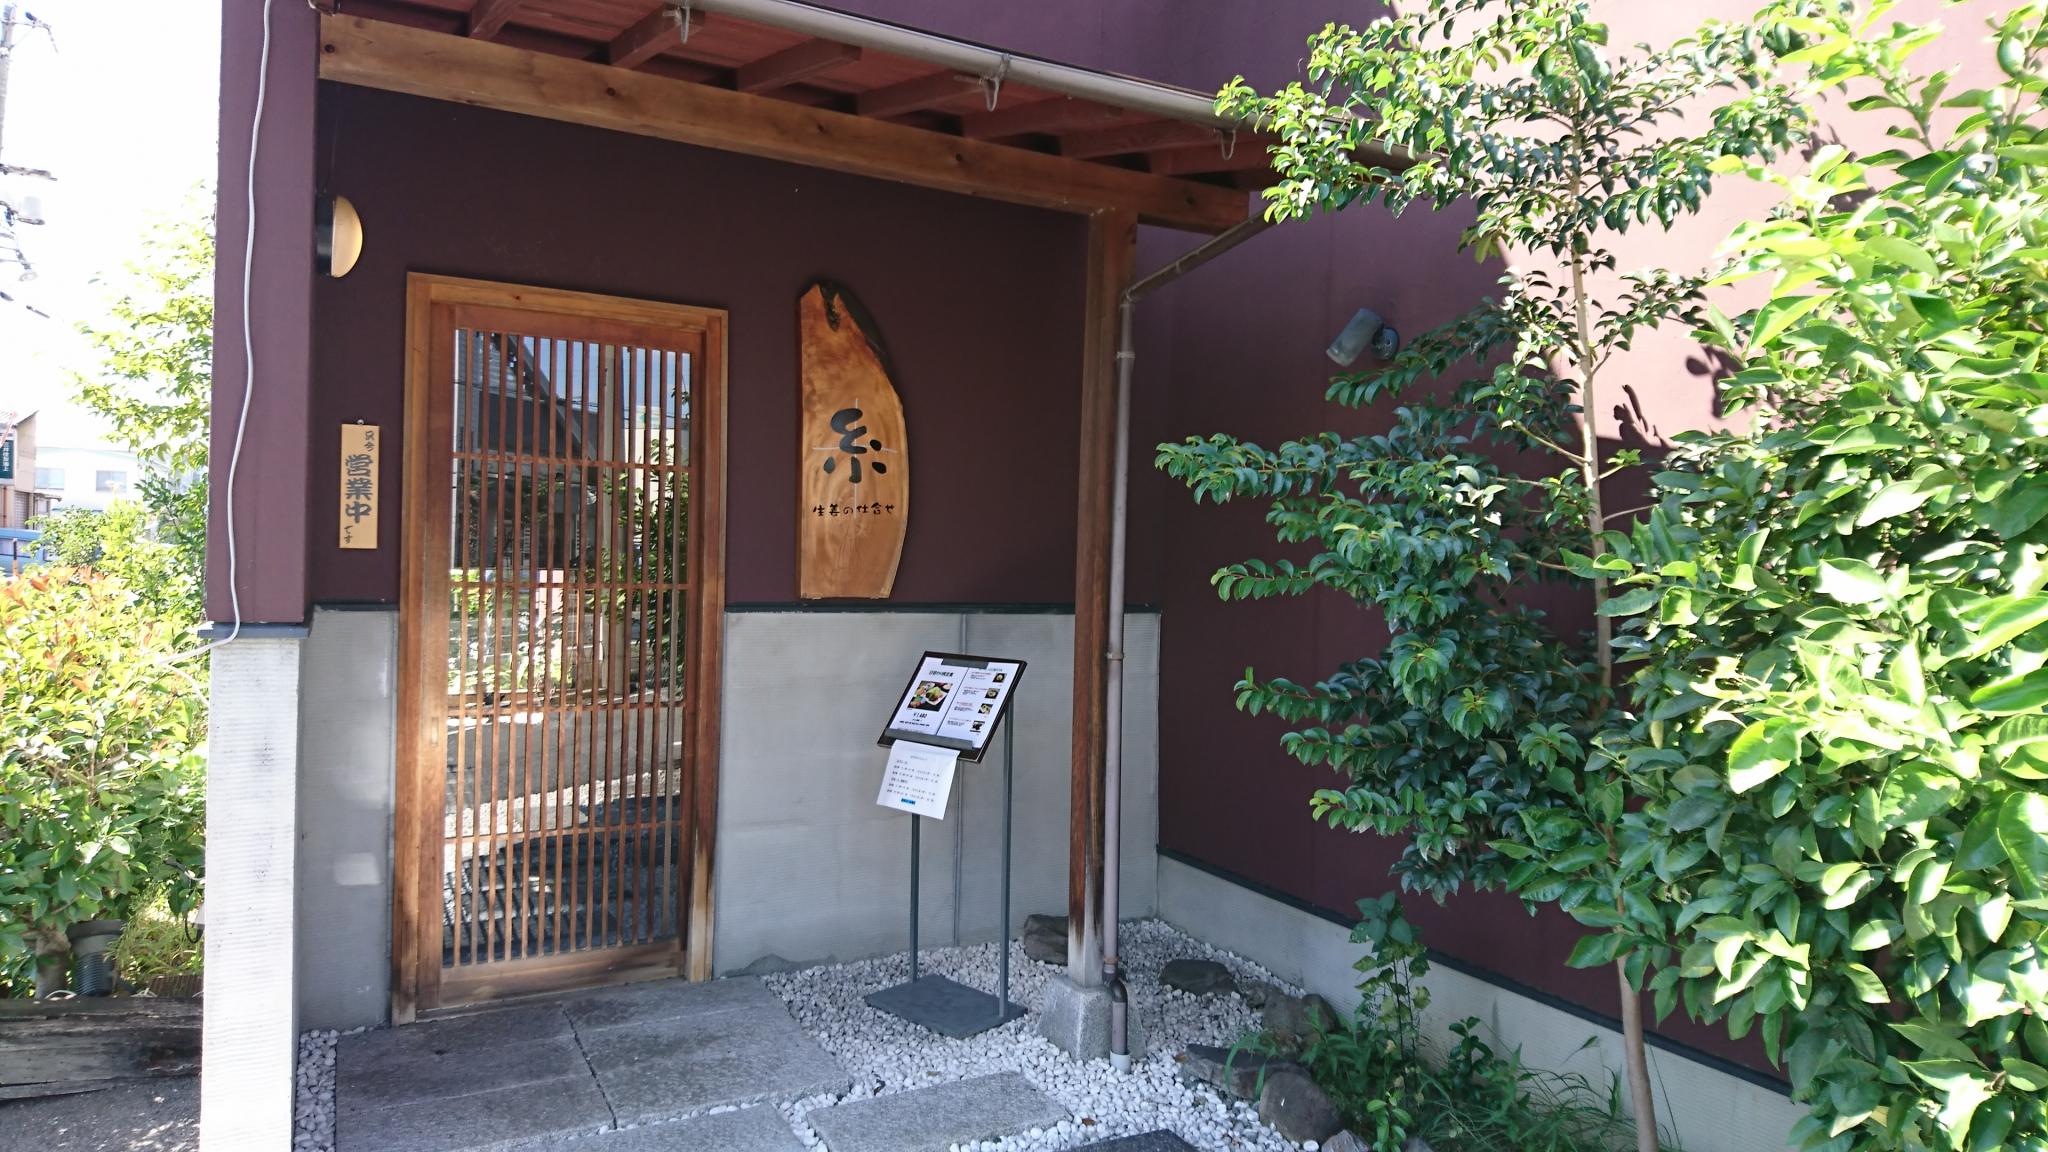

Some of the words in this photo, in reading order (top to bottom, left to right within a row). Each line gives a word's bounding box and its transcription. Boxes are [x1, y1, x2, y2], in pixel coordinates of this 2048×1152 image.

[823, 408, 887, 484] 糸
[345, 454, 373, 524] 営業中
